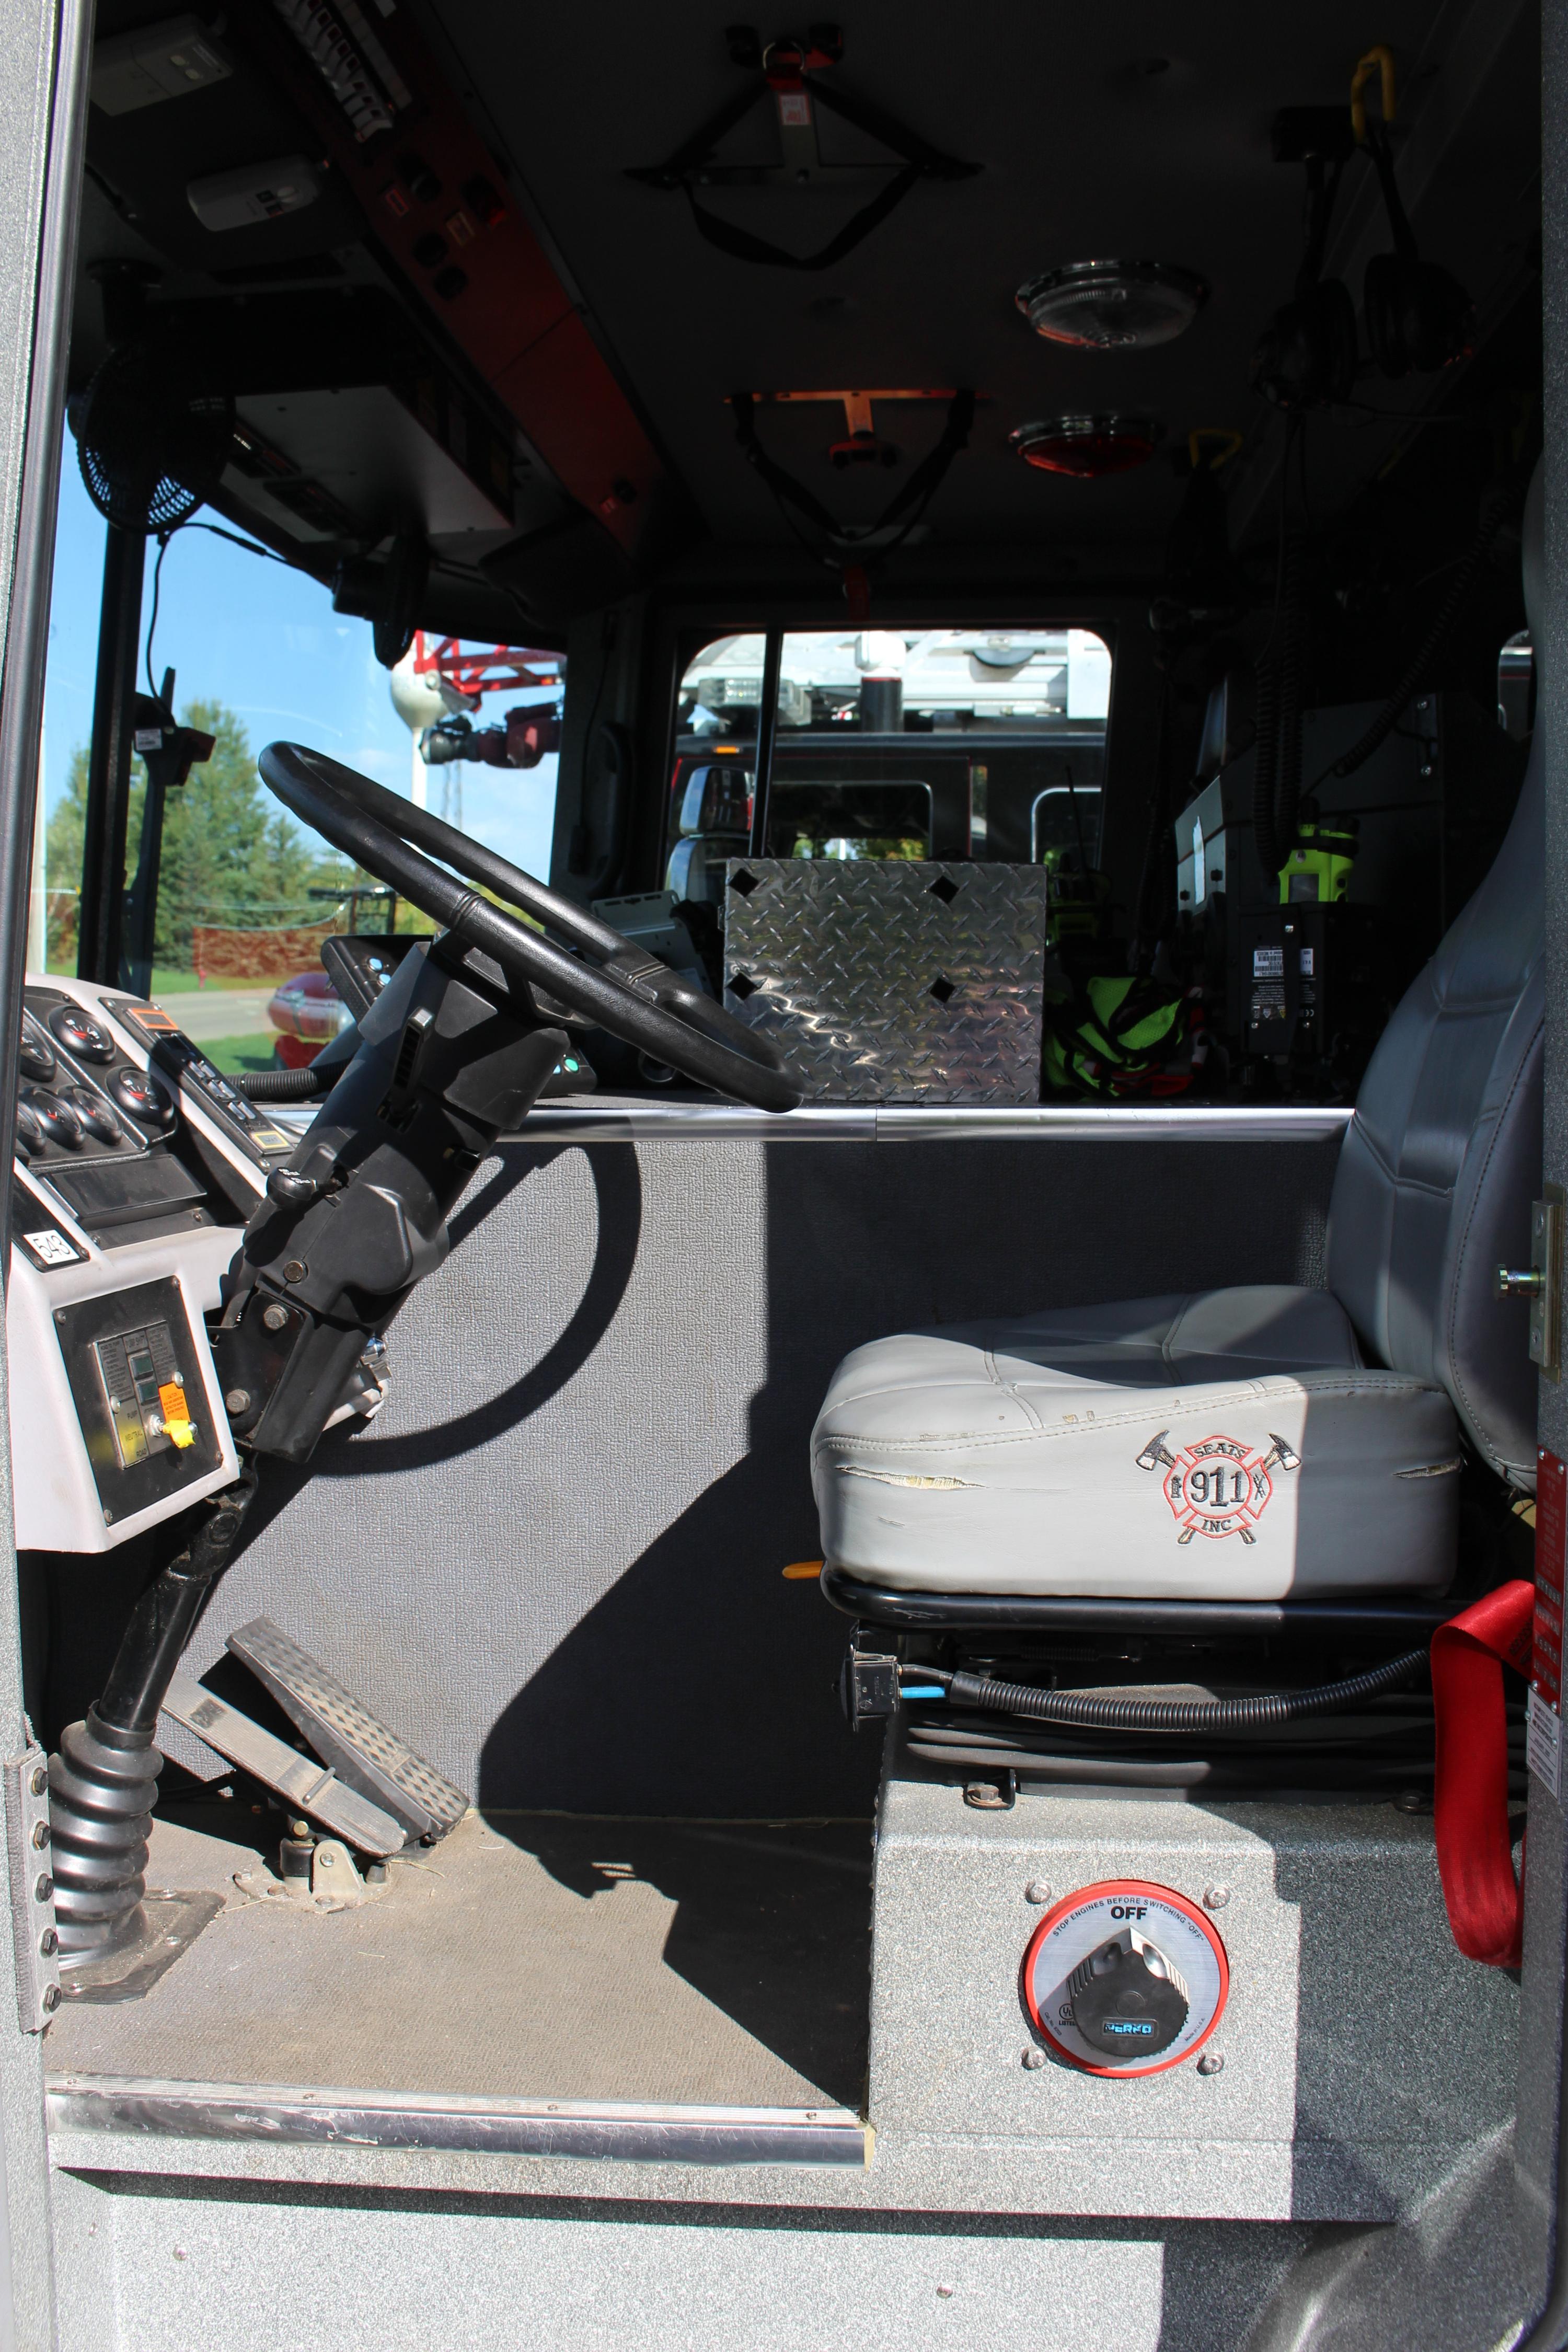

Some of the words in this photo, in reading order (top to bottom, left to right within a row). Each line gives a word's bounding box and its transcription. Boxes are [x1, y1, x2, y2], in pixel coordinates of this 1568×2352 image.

[33, 1235, 70, 1258] 543
[127, 1410, 137, 1420] PUMP
[125, 1431, 143, 1442] NEUTRAL
[136, 1448, 146, 1457] ROAD
[1194, 1443, 1246, 1459] SEATS
[1191, 1466, 1245, 1507] 911
[1201, 1519, 1232, 1532] INC
[1053, 1919, 1069, 1936] STOP
[1070, 1900, 1104, 1920] ENGINES
[1144, 1899, 1186, 1923] SWITCHING
[1111, 1906, 1147, 1920] OFF
[1184, 2032, 1194, 2041] Made
